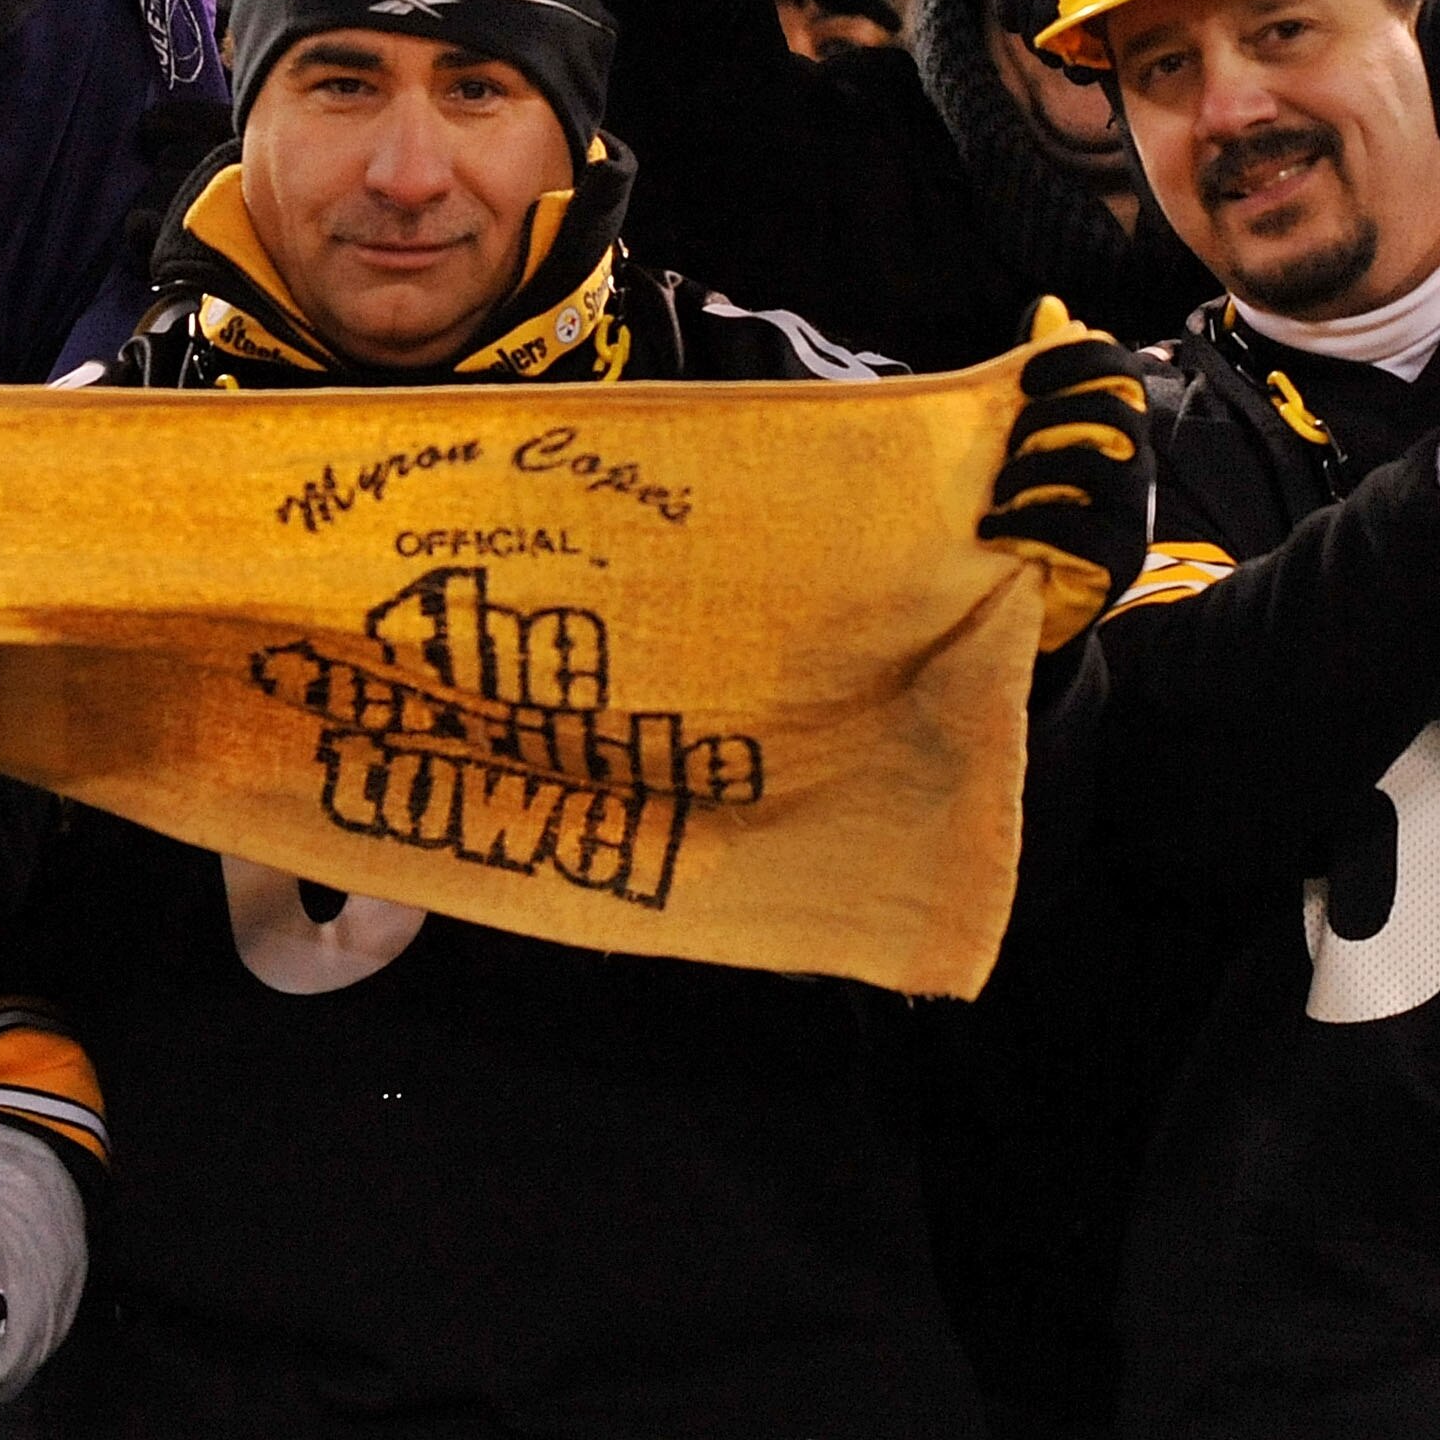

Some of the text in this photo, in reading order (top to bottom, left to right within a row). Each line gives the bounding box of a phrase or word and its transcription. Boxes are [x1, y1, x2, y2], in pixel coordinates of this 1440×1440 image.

[274, 426, 693, 533] Myron Cope's
[394, 527, 582, 558] OFFICIAL
[365, 566, 610, 712] the
[249, 639, 764, 804] terible
[316, 728, 689, 910] towel
